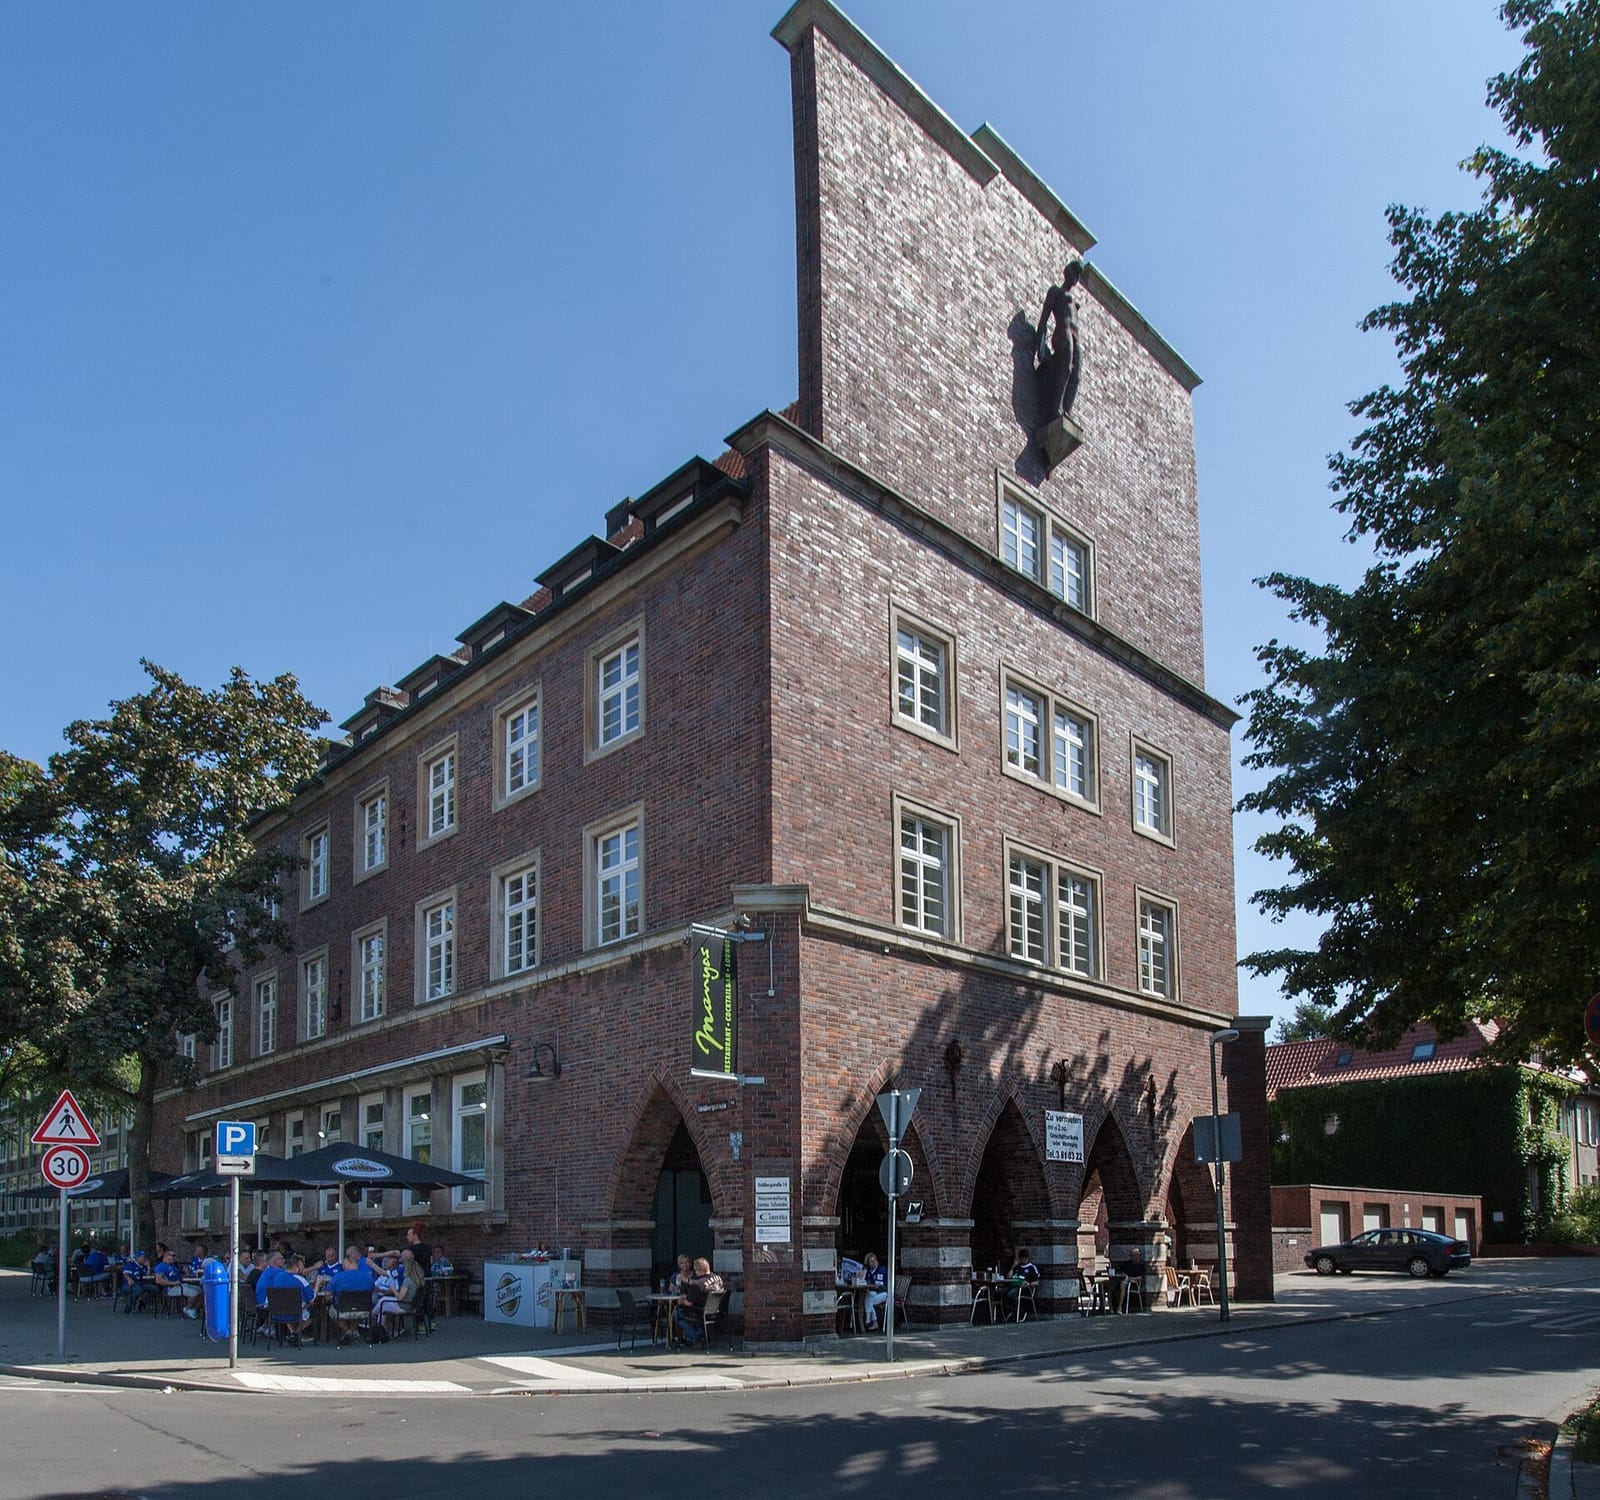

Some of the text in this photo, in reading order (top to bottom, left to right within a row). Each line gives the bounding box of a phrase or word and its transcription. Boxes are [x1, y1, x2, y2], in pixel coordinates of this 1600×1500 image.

[1046, 1112, 1082, 1124] Zu vermieten
[225, 1126, 247, 1152] P
[52, 1156, 79, 1176] 30
